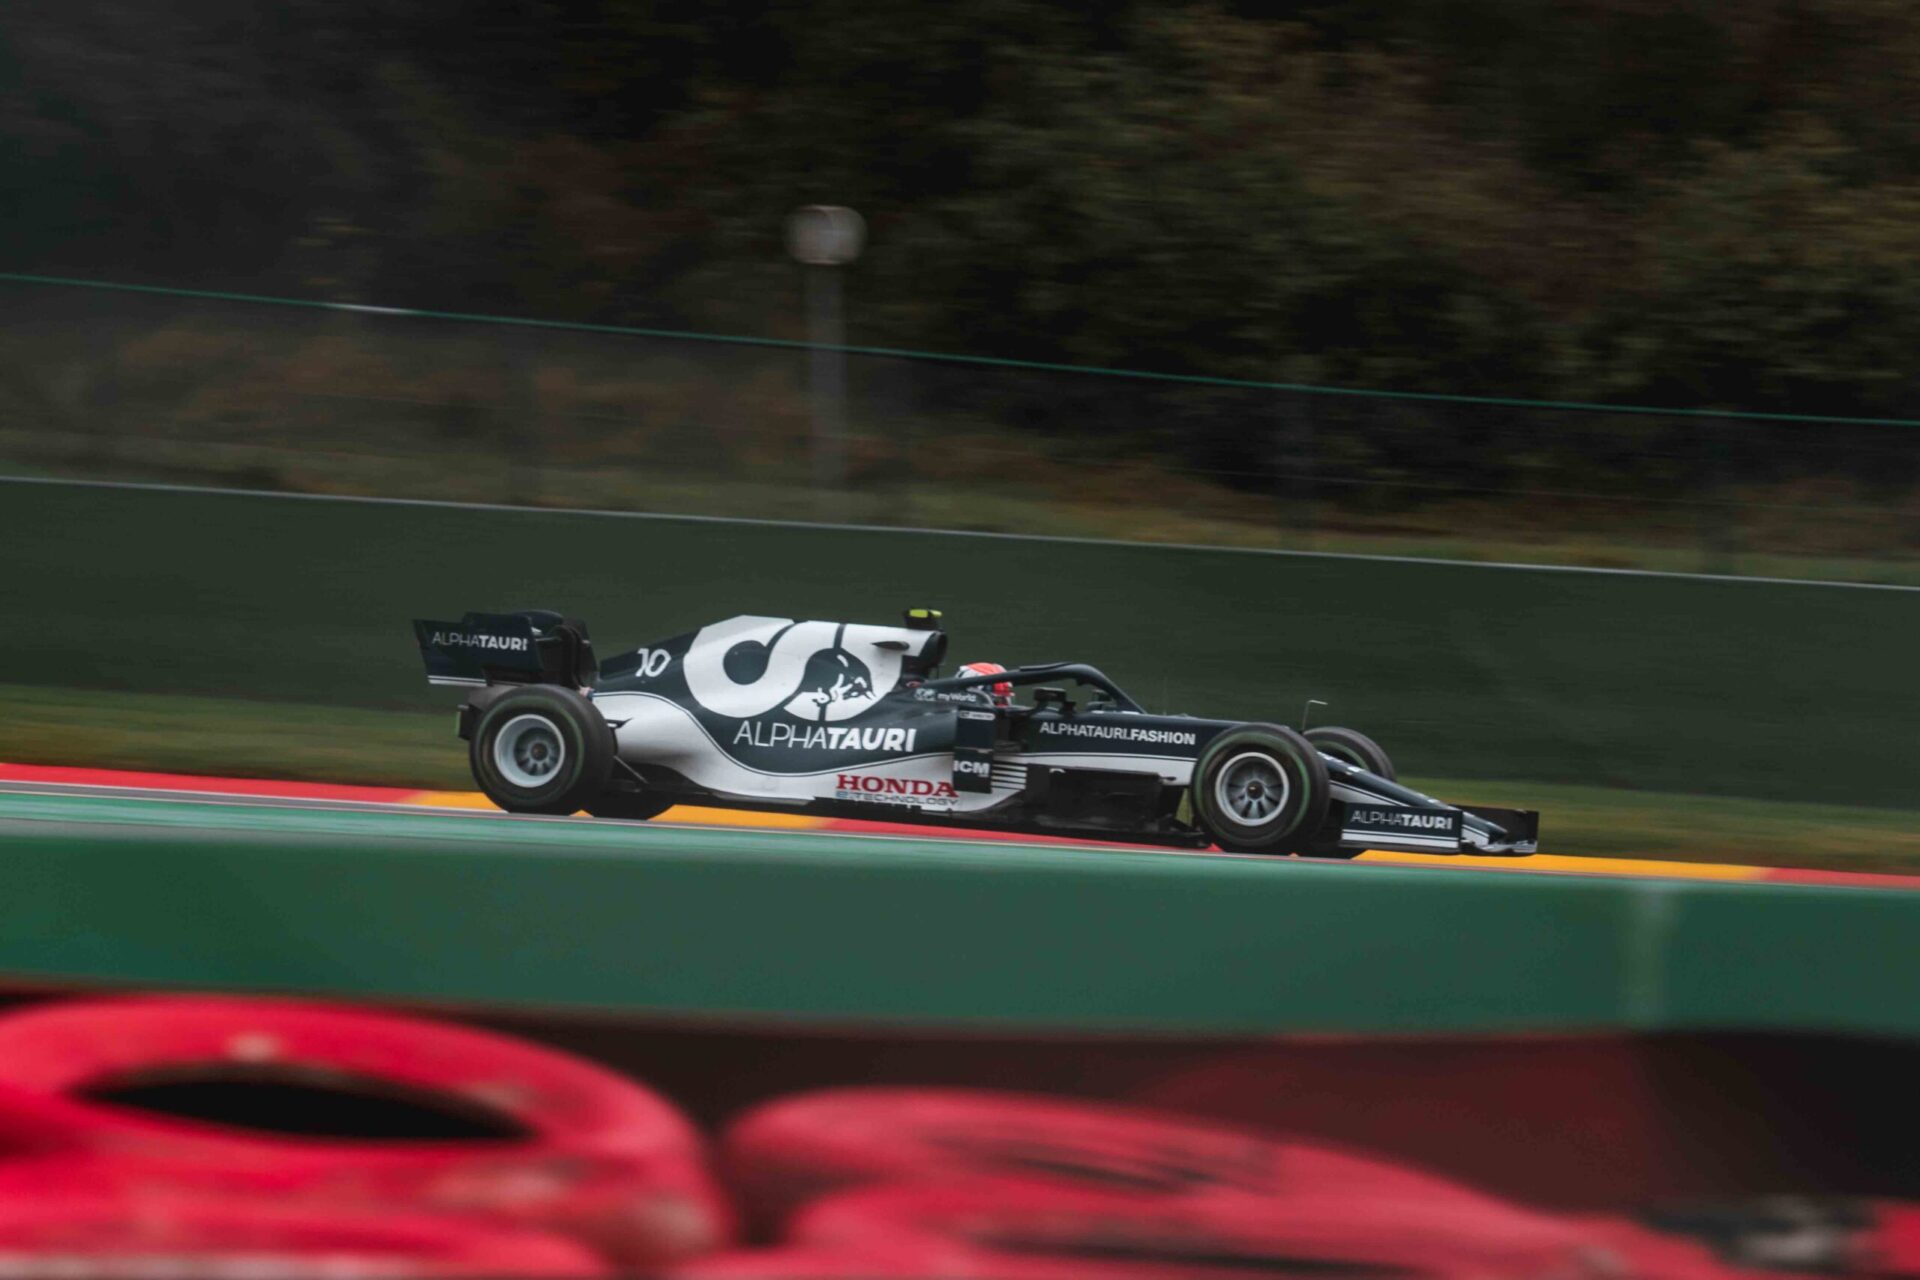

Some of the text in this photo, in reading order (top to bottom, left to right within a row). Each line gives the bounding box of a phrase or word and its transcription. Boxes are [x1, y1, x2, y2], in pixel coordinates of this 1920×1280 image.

[431, 631, 528, 651] ALPHATAURI
[635, 648, 672, 678] 10
[733, 720, 917, 753] ALPHATAURI
[1039, 721, 1196, 746] ALPHATAURI.FASHION
[836, 774, 959, 798] HONDA
[1350, 808, 1453, 831] ALPHATAURI
